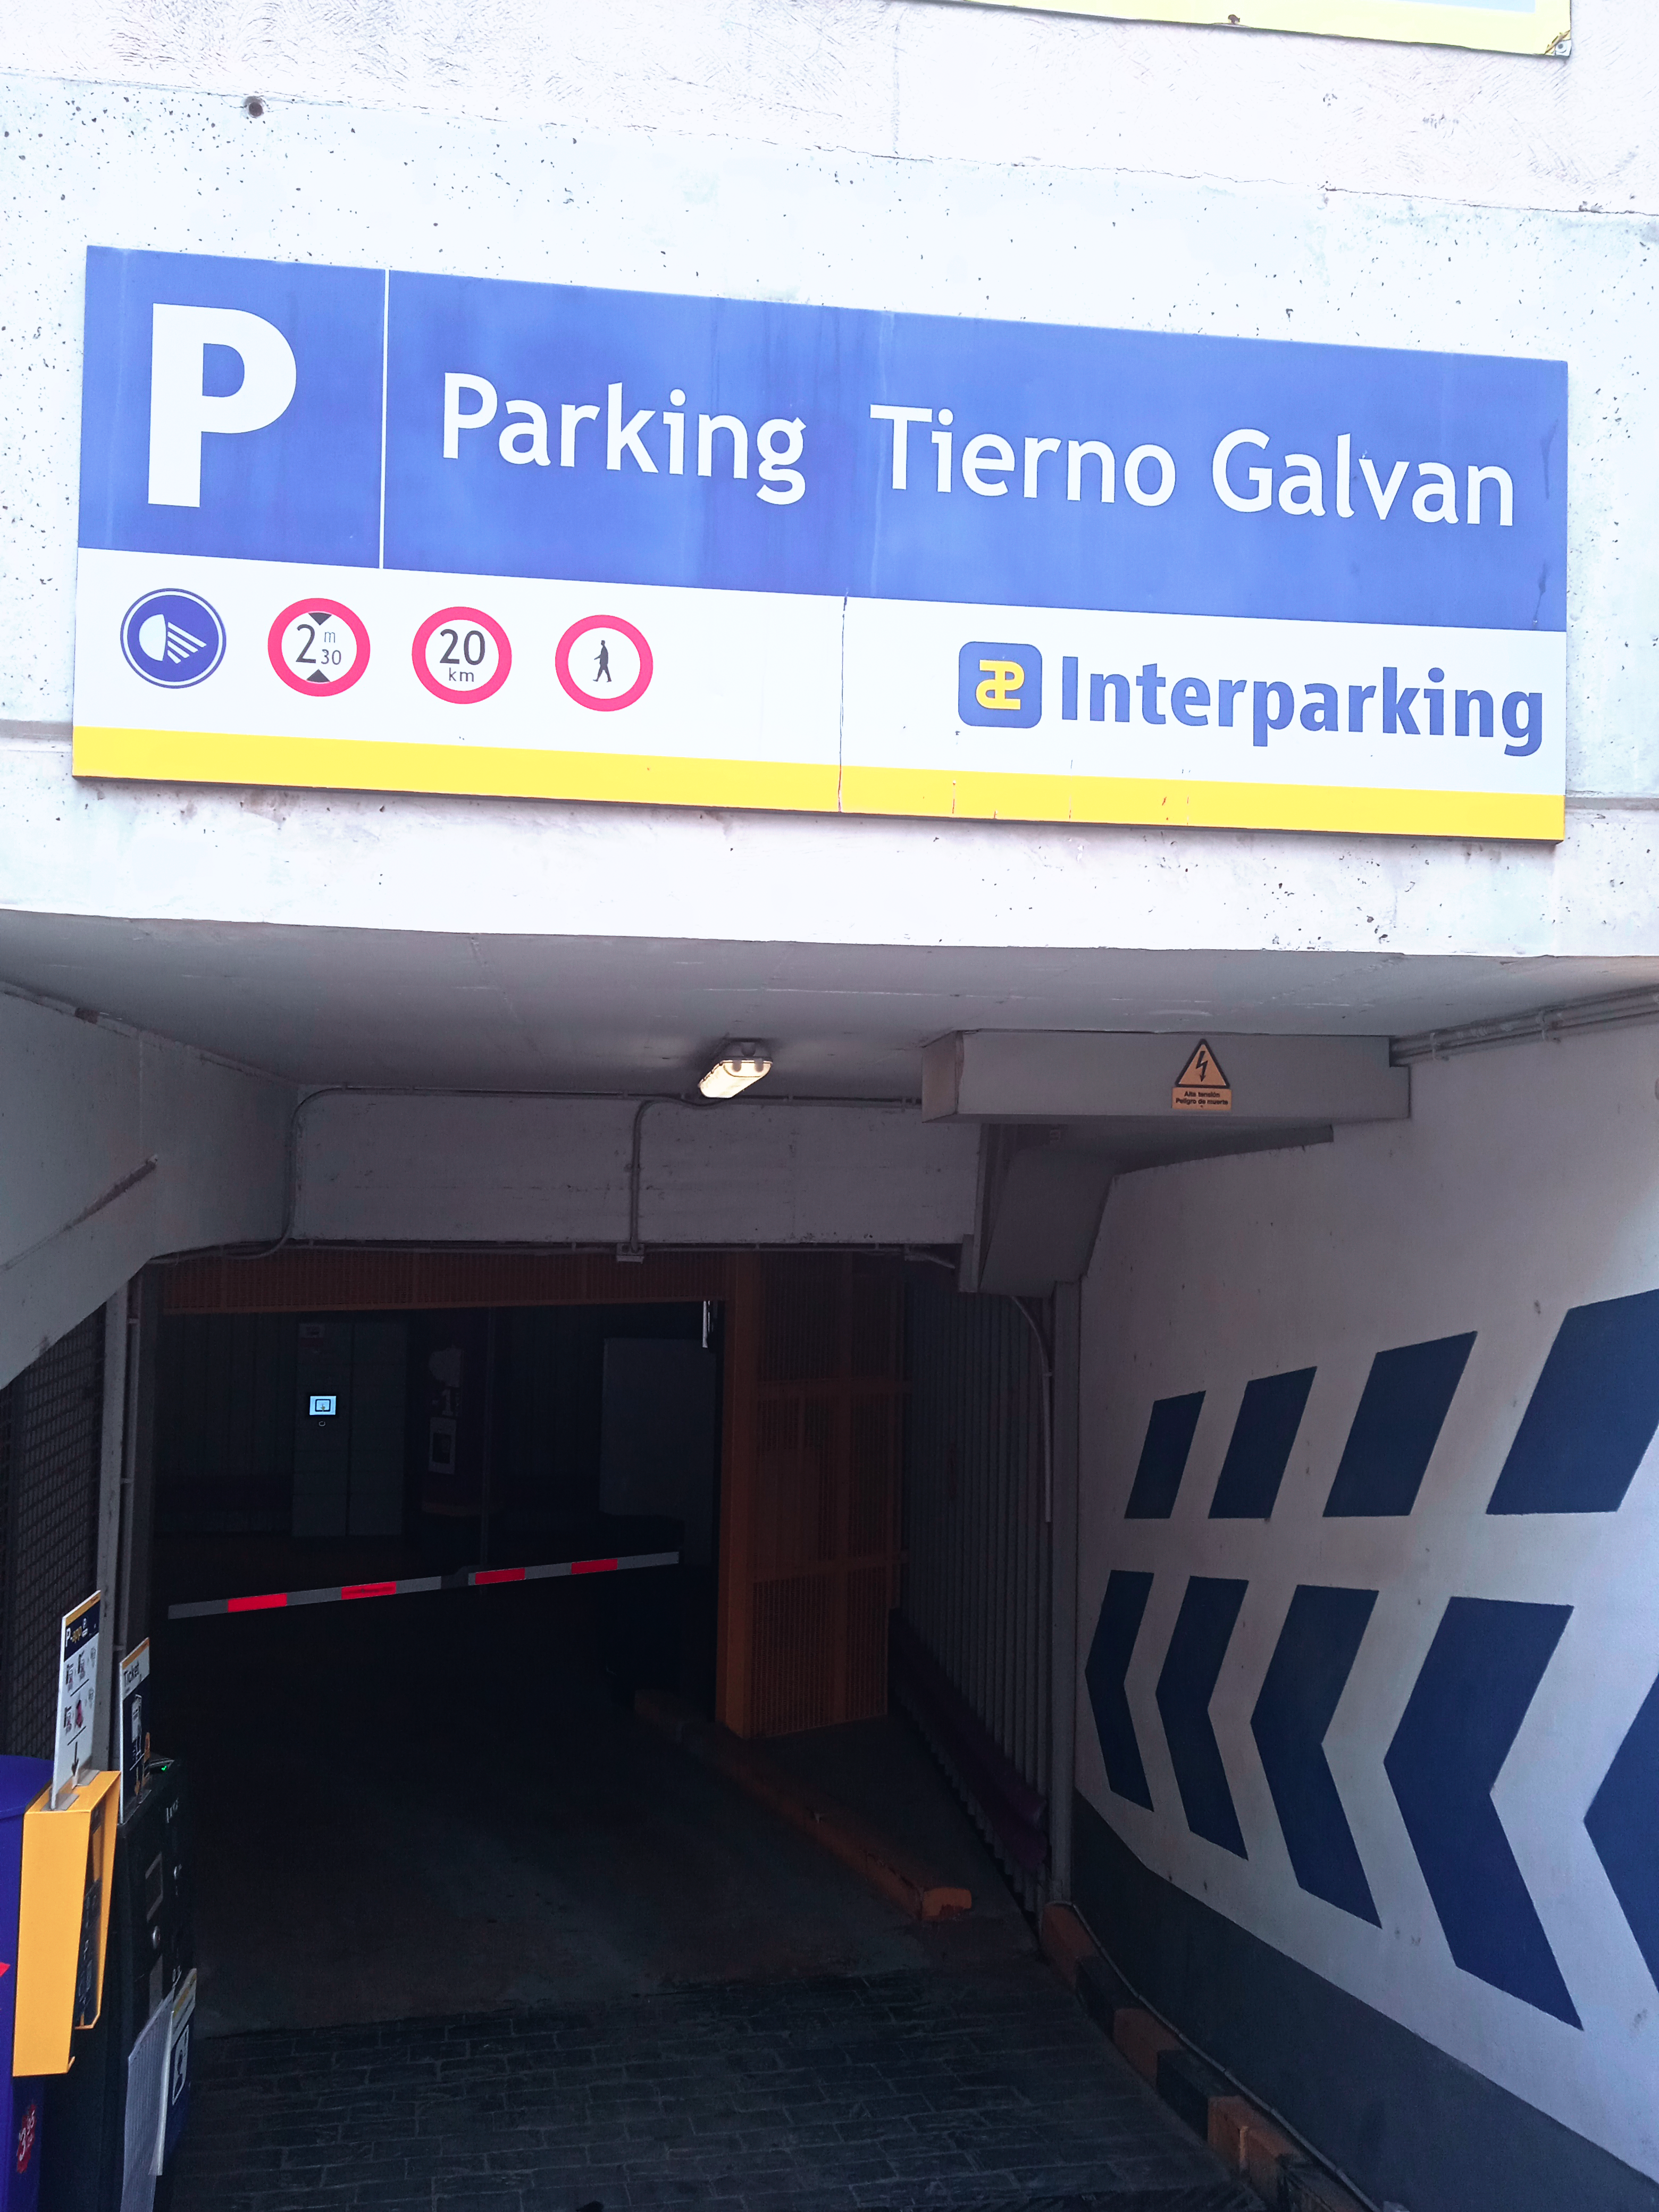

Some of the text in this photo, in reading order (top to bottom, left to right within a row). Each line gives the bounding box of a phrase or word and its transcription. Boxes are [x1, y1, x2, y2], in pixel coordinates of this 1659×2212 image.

[148, 304, 296, 508] P
[443, 372, 1513, 526] Parking Tierno Galvan
[296, 624, 316, 664] 2
[321, 649, 341, 665] 30
[439, 629, 485, 666] 20
[449, 667, 475, 682] km
[1061, 656, 1543, 757] Interparking
